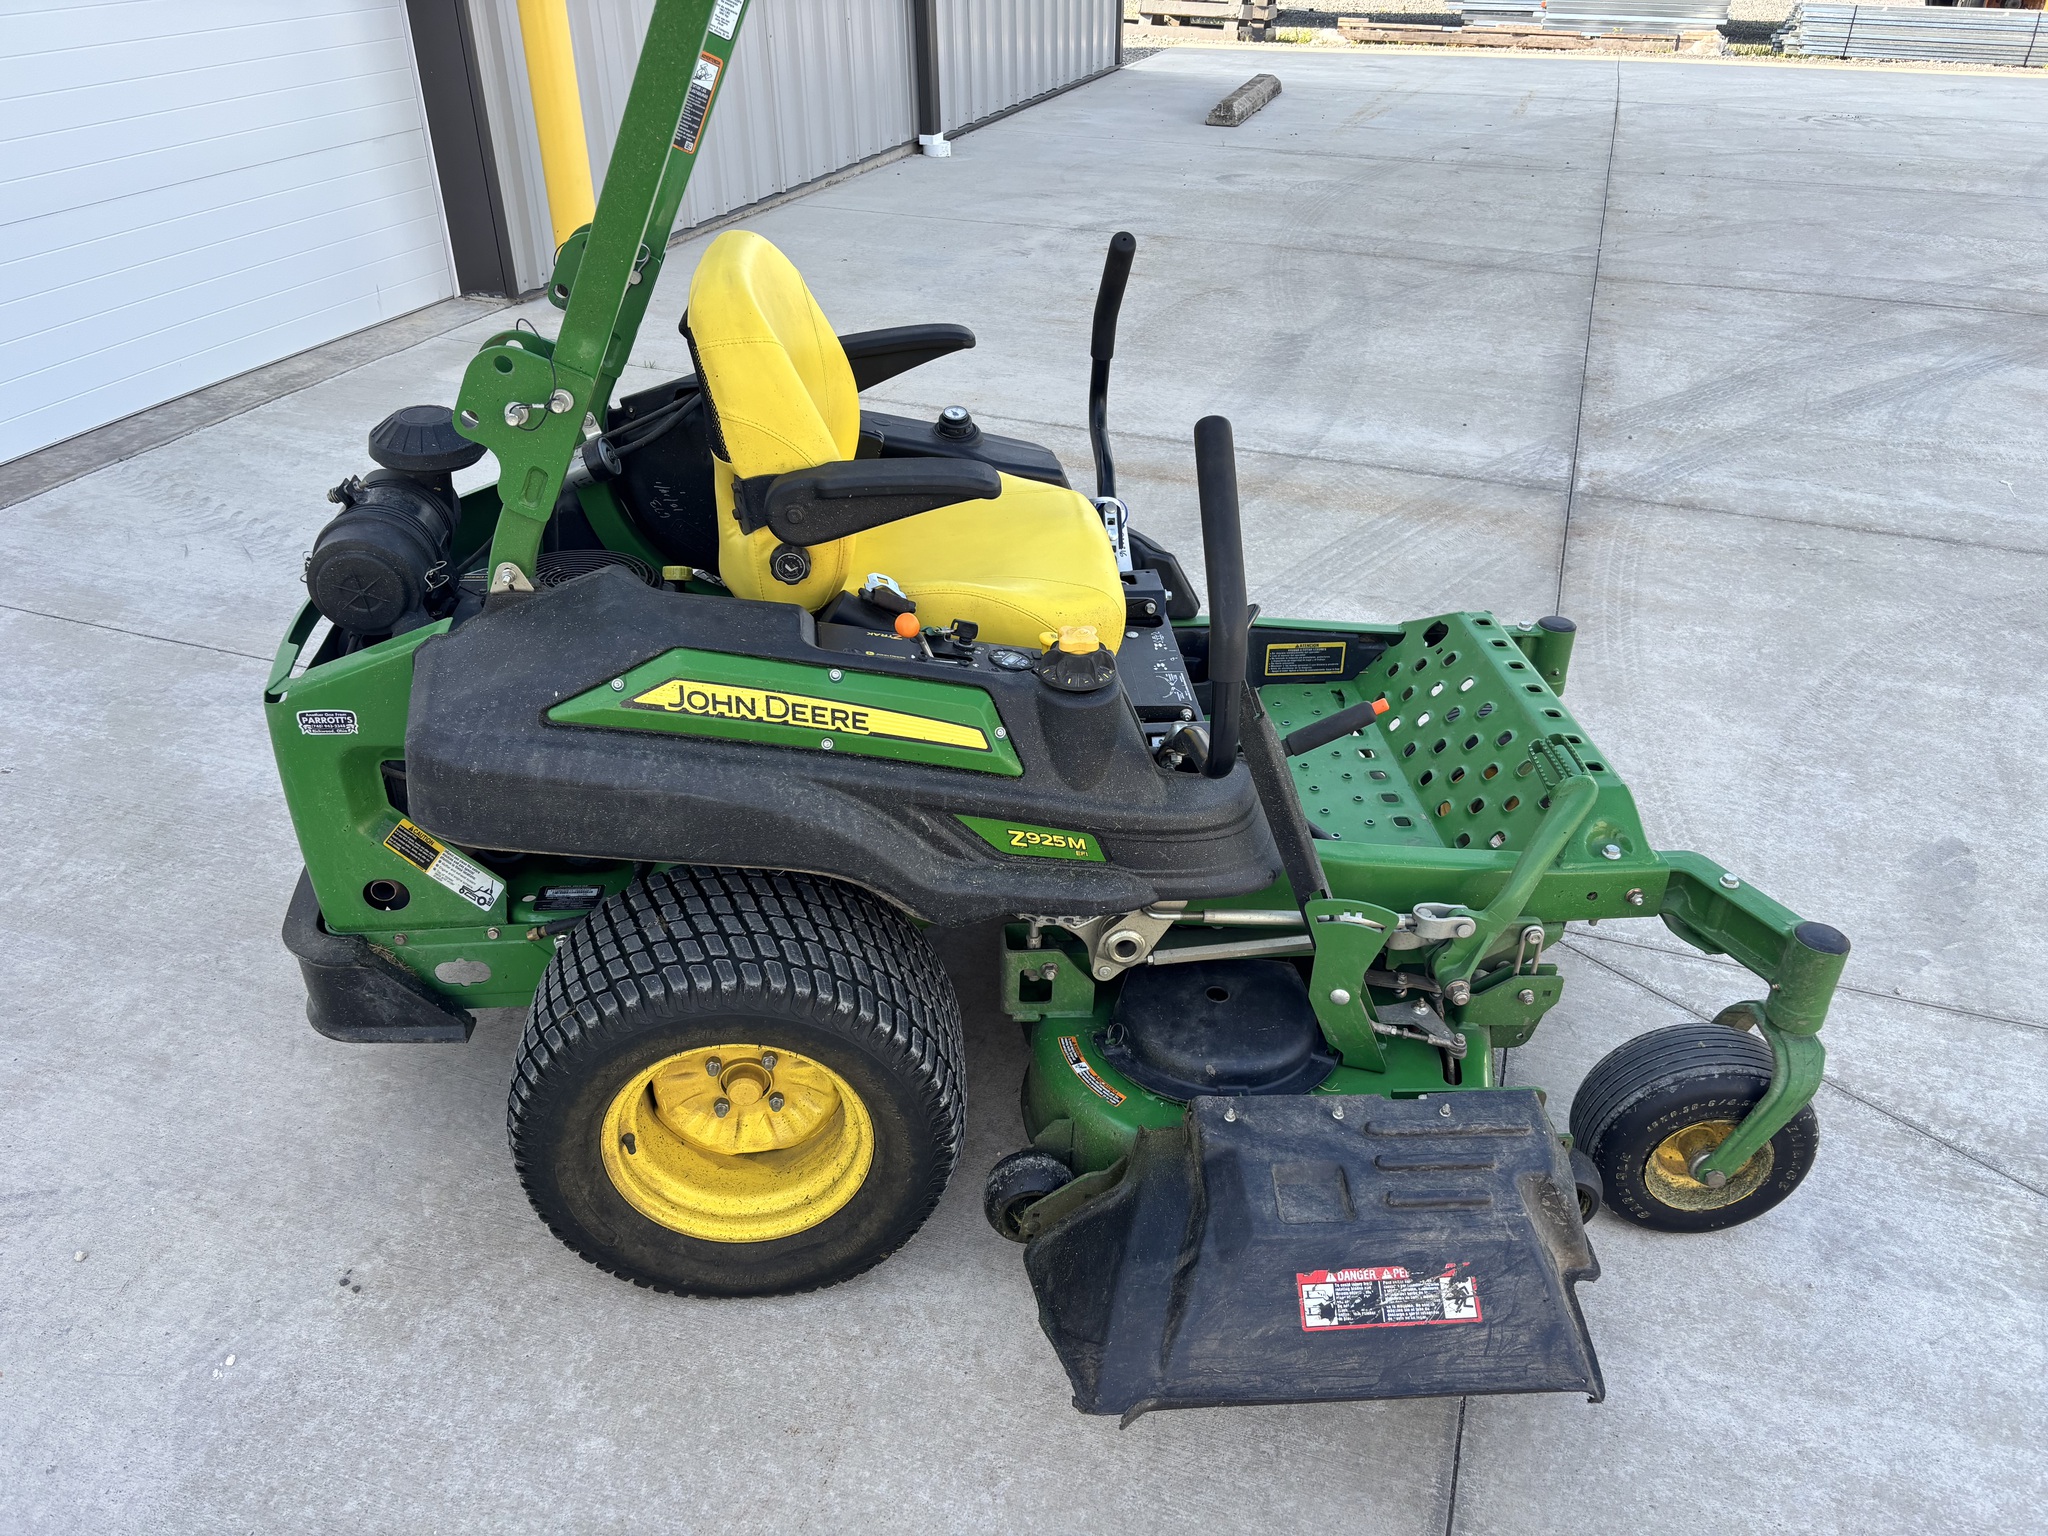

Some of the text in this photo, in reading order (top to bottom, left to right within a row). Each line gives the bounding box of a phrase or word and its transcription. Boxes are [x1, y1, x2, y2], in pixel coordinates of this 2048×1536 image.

[667, 684, 869, 732] JOHN DEERE
[302, 716, 353, 724] PARROTT'S
[413, 828, 435, 846] CAUTION
[1007, 830, 1086, 850] Z925M
[1337, 1269, 1376, 1281] DANGER
